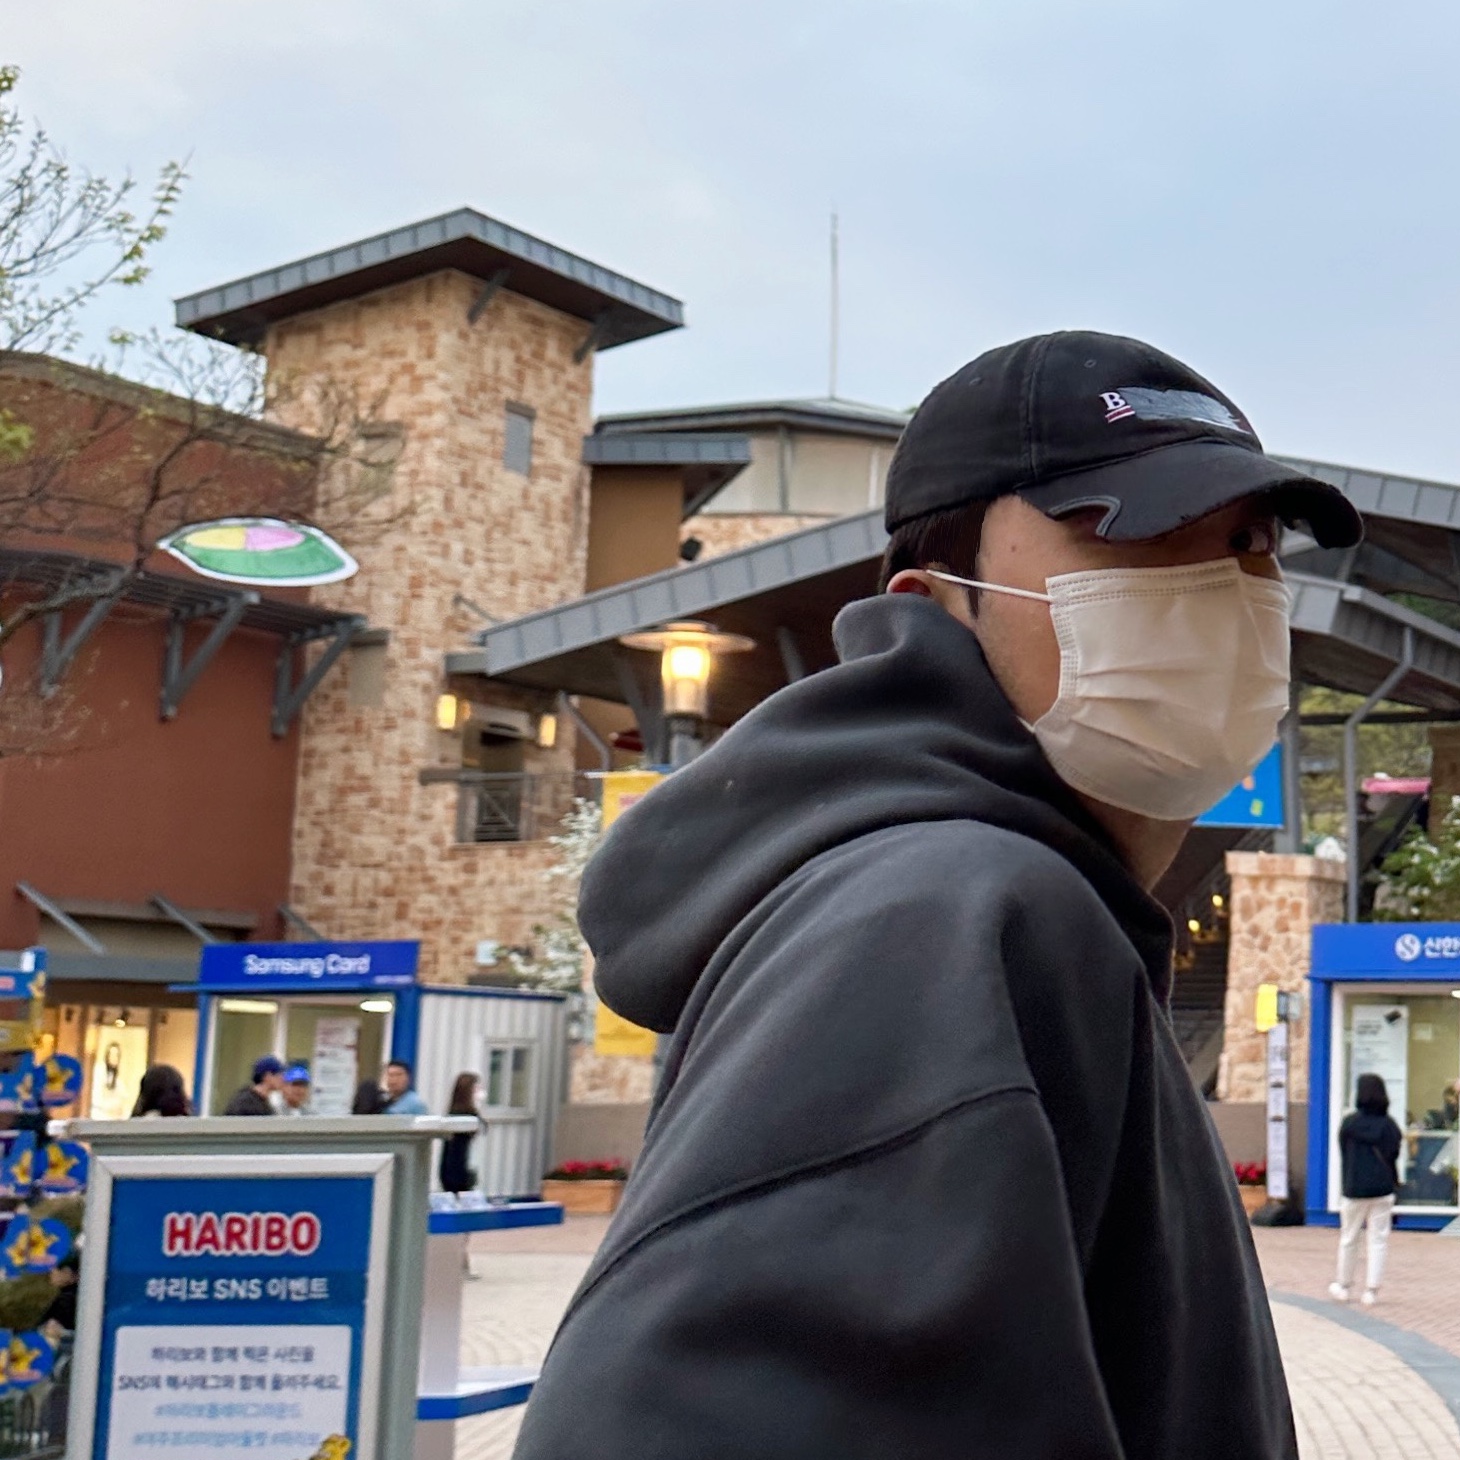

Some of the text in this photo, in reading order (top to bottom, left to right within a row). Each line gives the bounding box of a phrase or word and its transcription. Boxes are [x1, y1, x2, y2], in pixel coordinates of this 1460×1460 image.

[244, 954, 371, 978] Samsung Card
[164, 1212, 321, 1257] HARIBO
[145, 1276, 330, 1302] 하리보 SNS 이벤트
